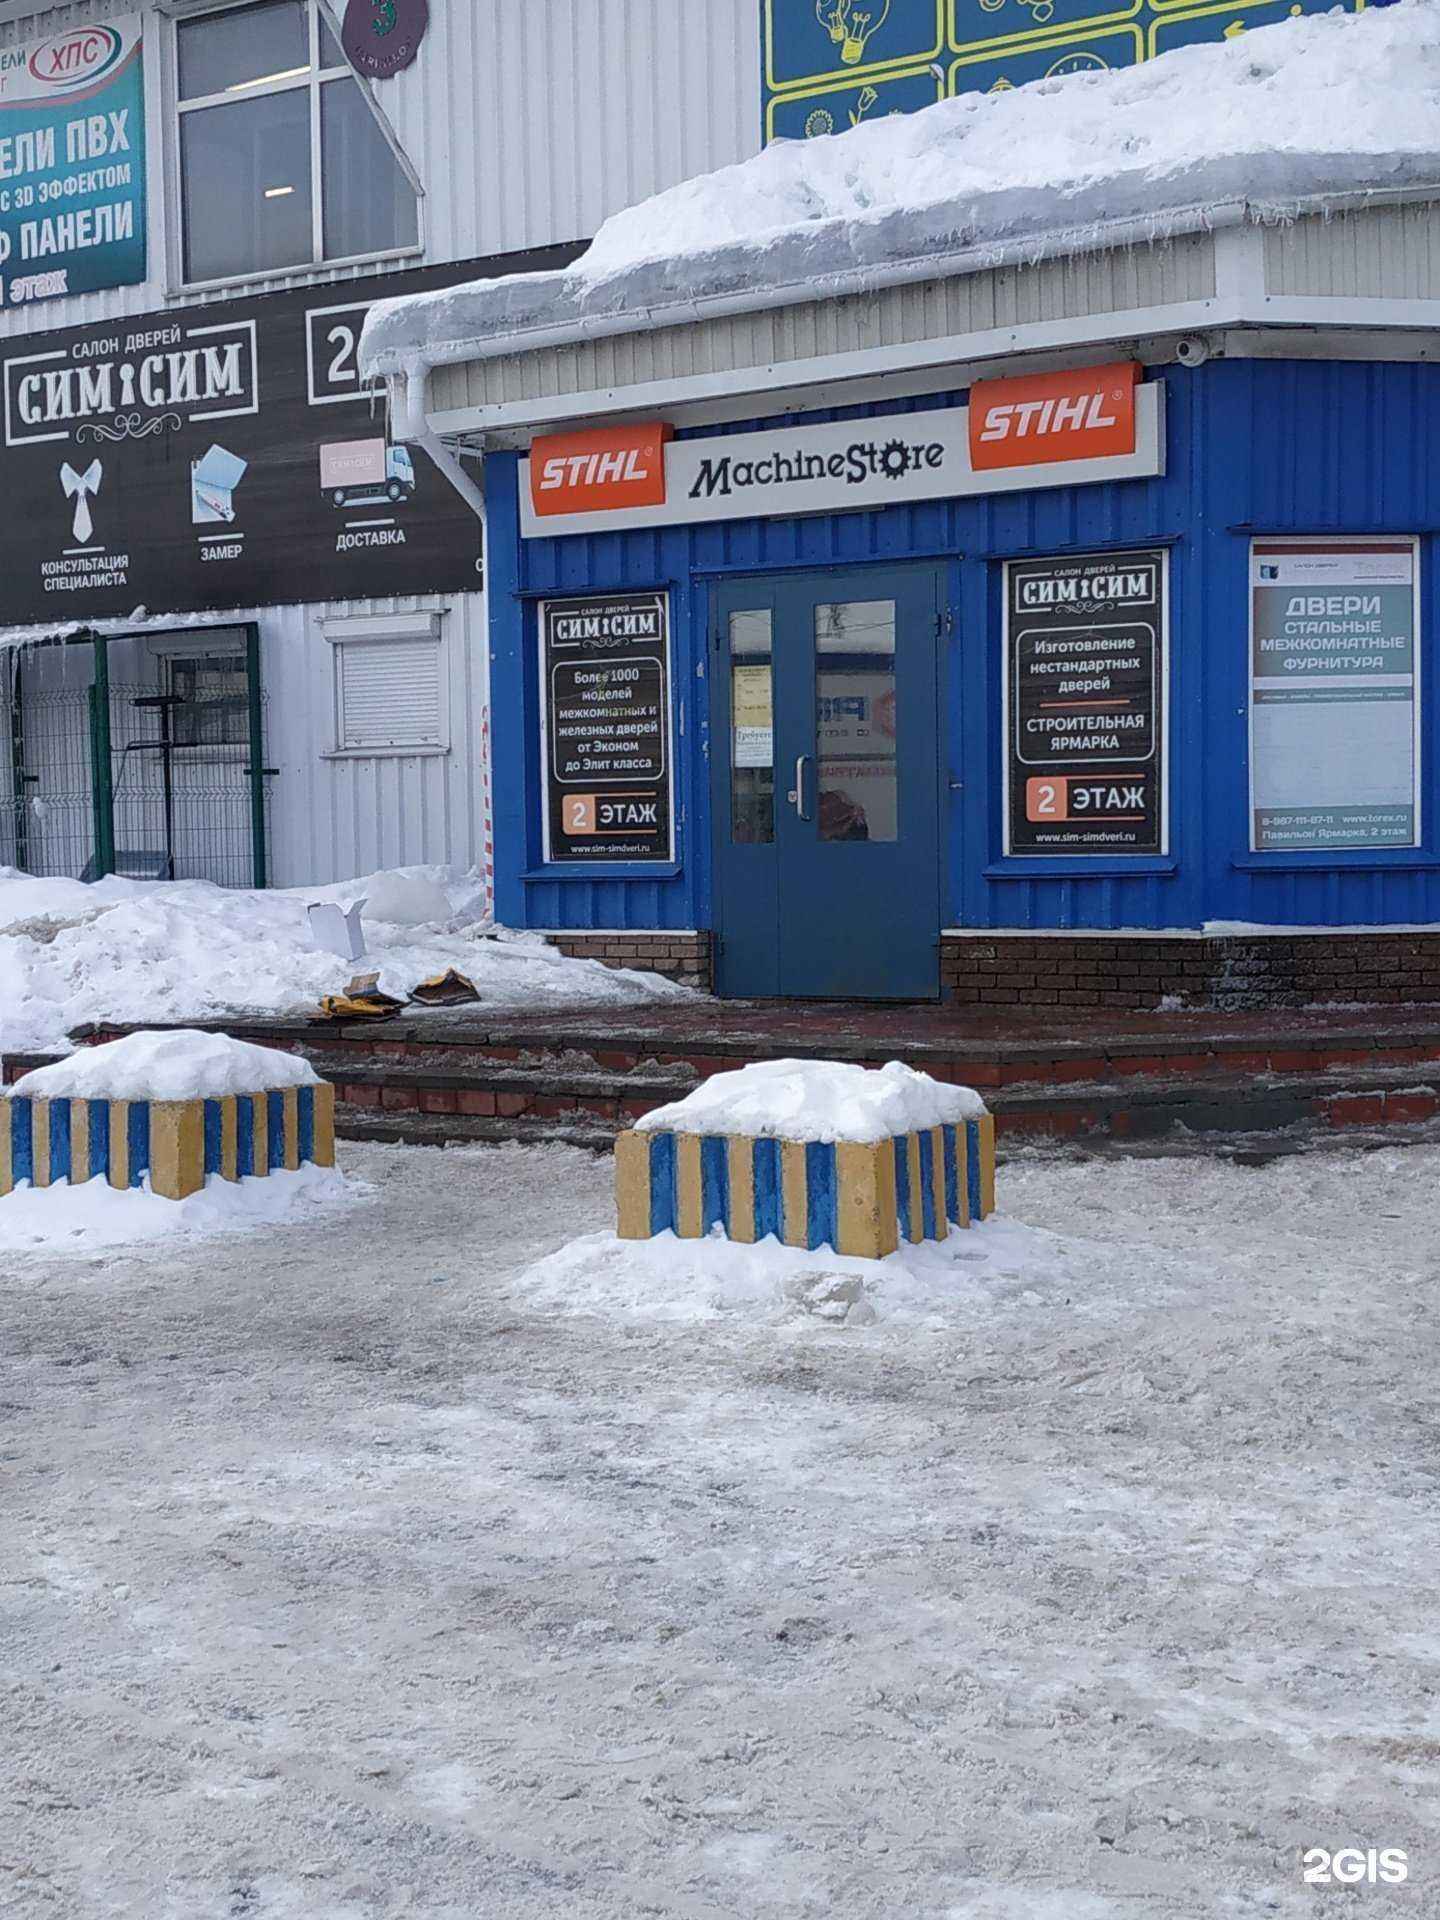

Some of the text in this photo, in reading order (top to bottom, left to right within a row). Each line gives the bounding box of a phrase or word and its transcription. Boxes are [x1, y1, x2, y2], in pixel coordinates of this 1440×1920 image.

[49, 37, 98, 74] ХПС
[66, 108, 130, 163] ПВХ
[15, 185, 34, 209] 3D
[38, 163, 131, 203] ЭФФЕКТОМ
[20, 200, 133, 260] ПАНЕЛИ
[72, 324, 181, 360] САЛОН ДВЕРЕЙ
[326, 325, 357, 382] 2
[18, 343, 245, 425] СИМ СИМ
[979, 392, 1116, 442] STIHL
[540, 449, 648, 490] STIHL
[335, 529, 406, 552] ДОСТАВКА
[200, 544, 243, 561] ЗАМЕР
[41, 555, 129, 576] КОНСУЛЬТАЦИЯ
[1054, 564, 1116, 577] САЛОН ДВЕРЕЙ
[44, 572, 127, 592] СПЕЦИАЛИСТА
[1023, 573, 1149, 605] СИМ СИМ
[1285, 596, 1381, 616] ДВЕРИ
[557, 613, 656, 640] СИМ СИМ
[1285, 620, 1382, 634] СТАЛЬНЫЕ
[1034, 638, 1136, 654] Изготовление
[1260, 636, 1406, 651] МЕЖКОМНАТНЫЕ
[1030, 657, 1141, 674] нестандартных
[1283, 656, 1384, 670] ФУРНИТУРА
[574, 668, 639, 684] Более 1000
[1058, 676, 1110, 694] дверей
[582, 687, 632, 701] моделей
[559, 706, 657, 719] межкомнатных и
[559, 721, 658, 737] железных дверей
[1026, 714, 1145, 732] СТРОИТЕЛЬНАЯ
[577, 741, 639, 753] от Эконом
[1050, 735, 1120, 750] ЯРМАРКА
[565, 758, 652, 772] до Элит класса
[1038, 785, 1145, 813] 2 ЭТАЖ
[572, 802, 657, 827] 2 ЭТАЖ
[1036, 832, 1136, 843] www.sim-simdveri.ru
[1262, 829, 1314, 841] Павильон
[1371, 827, 1379, 836] 2
[1381, 828, 1407, 836] этаж
